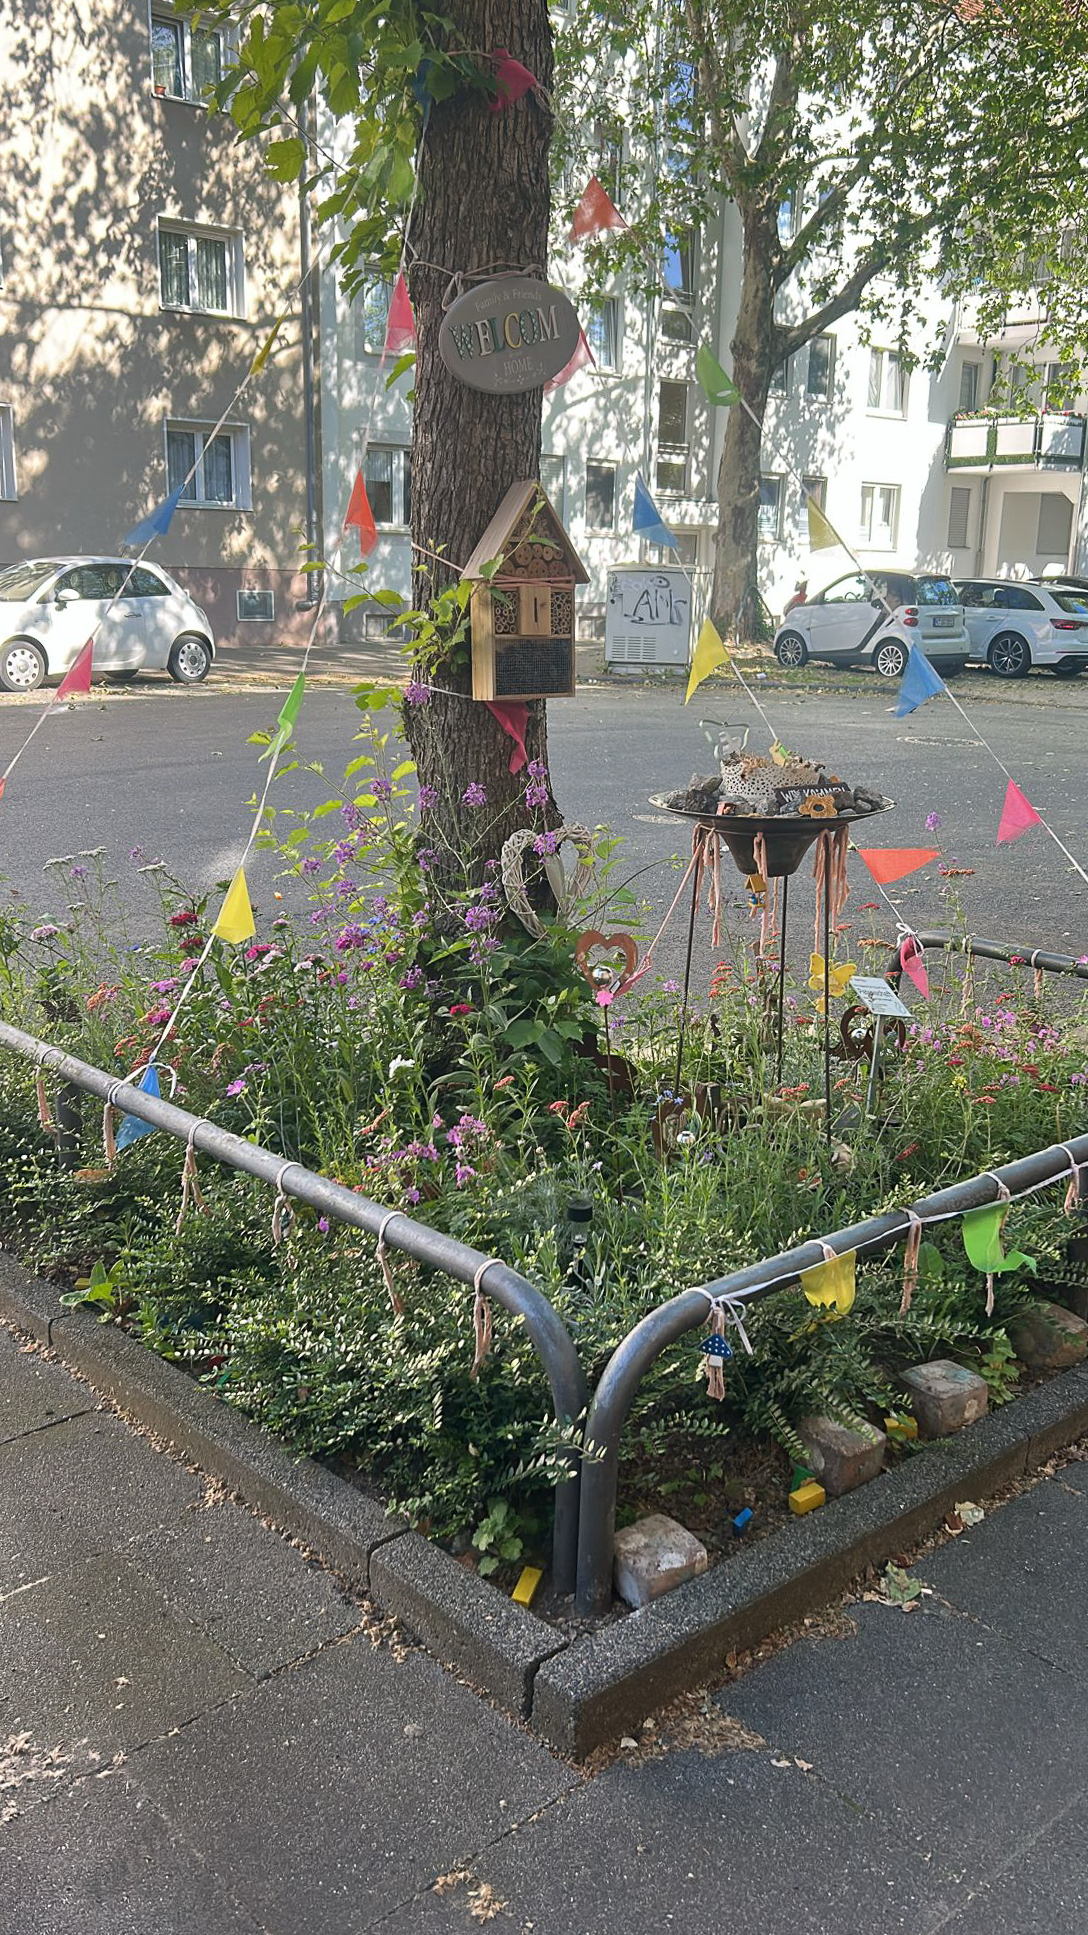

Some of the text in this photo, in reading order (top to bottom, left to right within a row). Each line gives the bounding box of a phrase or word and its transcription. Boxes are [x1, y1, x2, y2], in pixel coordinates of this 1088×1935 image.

[475, 291, 502, 313] Family
[512, 288, 542, 301] Friends
[448, 304, 561, 361] WELCOM
[503, 356, 533, 377] HOME
